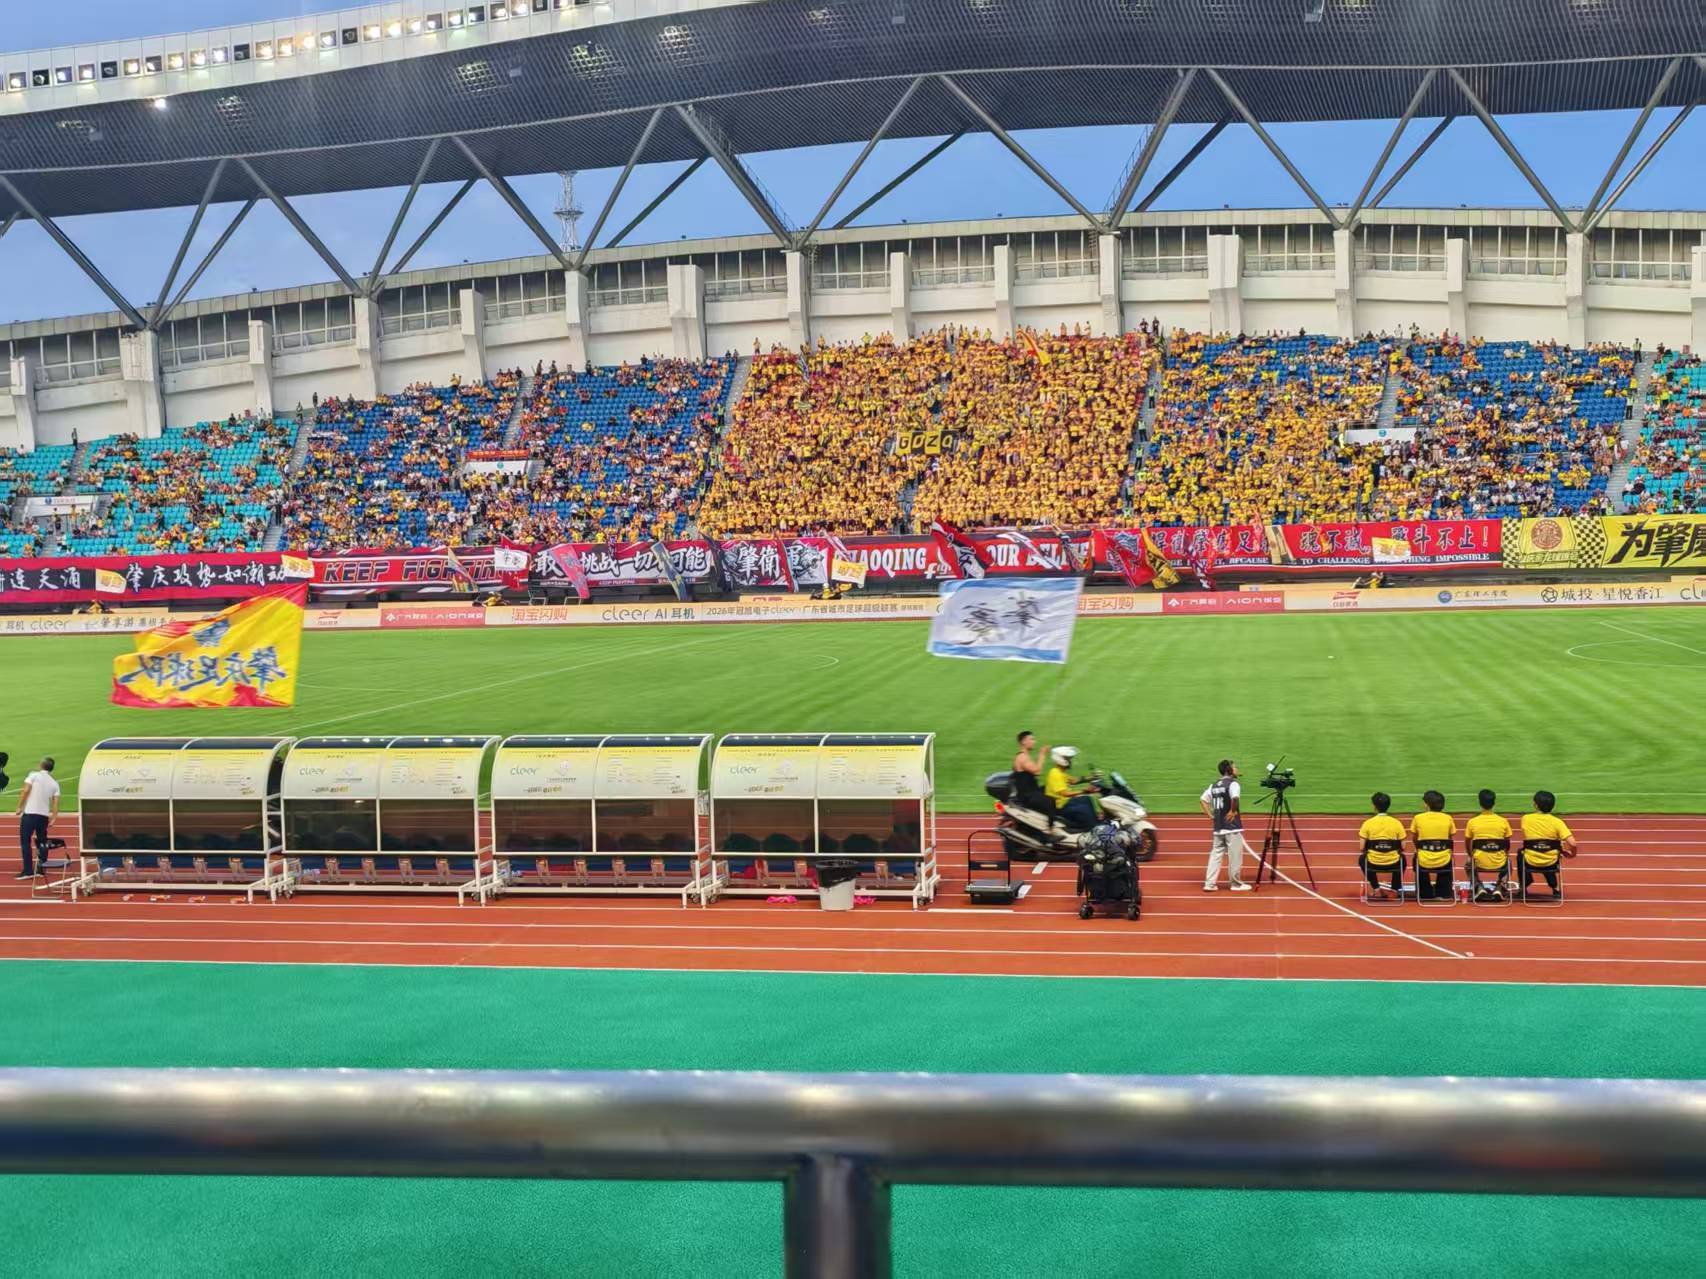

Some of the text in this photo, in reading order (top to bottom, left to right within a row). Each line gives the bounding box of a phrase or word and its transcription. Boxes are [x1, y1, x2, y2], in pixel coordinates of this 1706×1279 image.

[1317, 557, 1370, 565] CHALLENGE
[1435, 553, 1490, 562] IMPOSSIBLE
[324, 561, 391, 582] KEEP
[512, 608, 567, 621] 淘宝闪购
[602, 608, 695, 621] cleer AI 耳机
